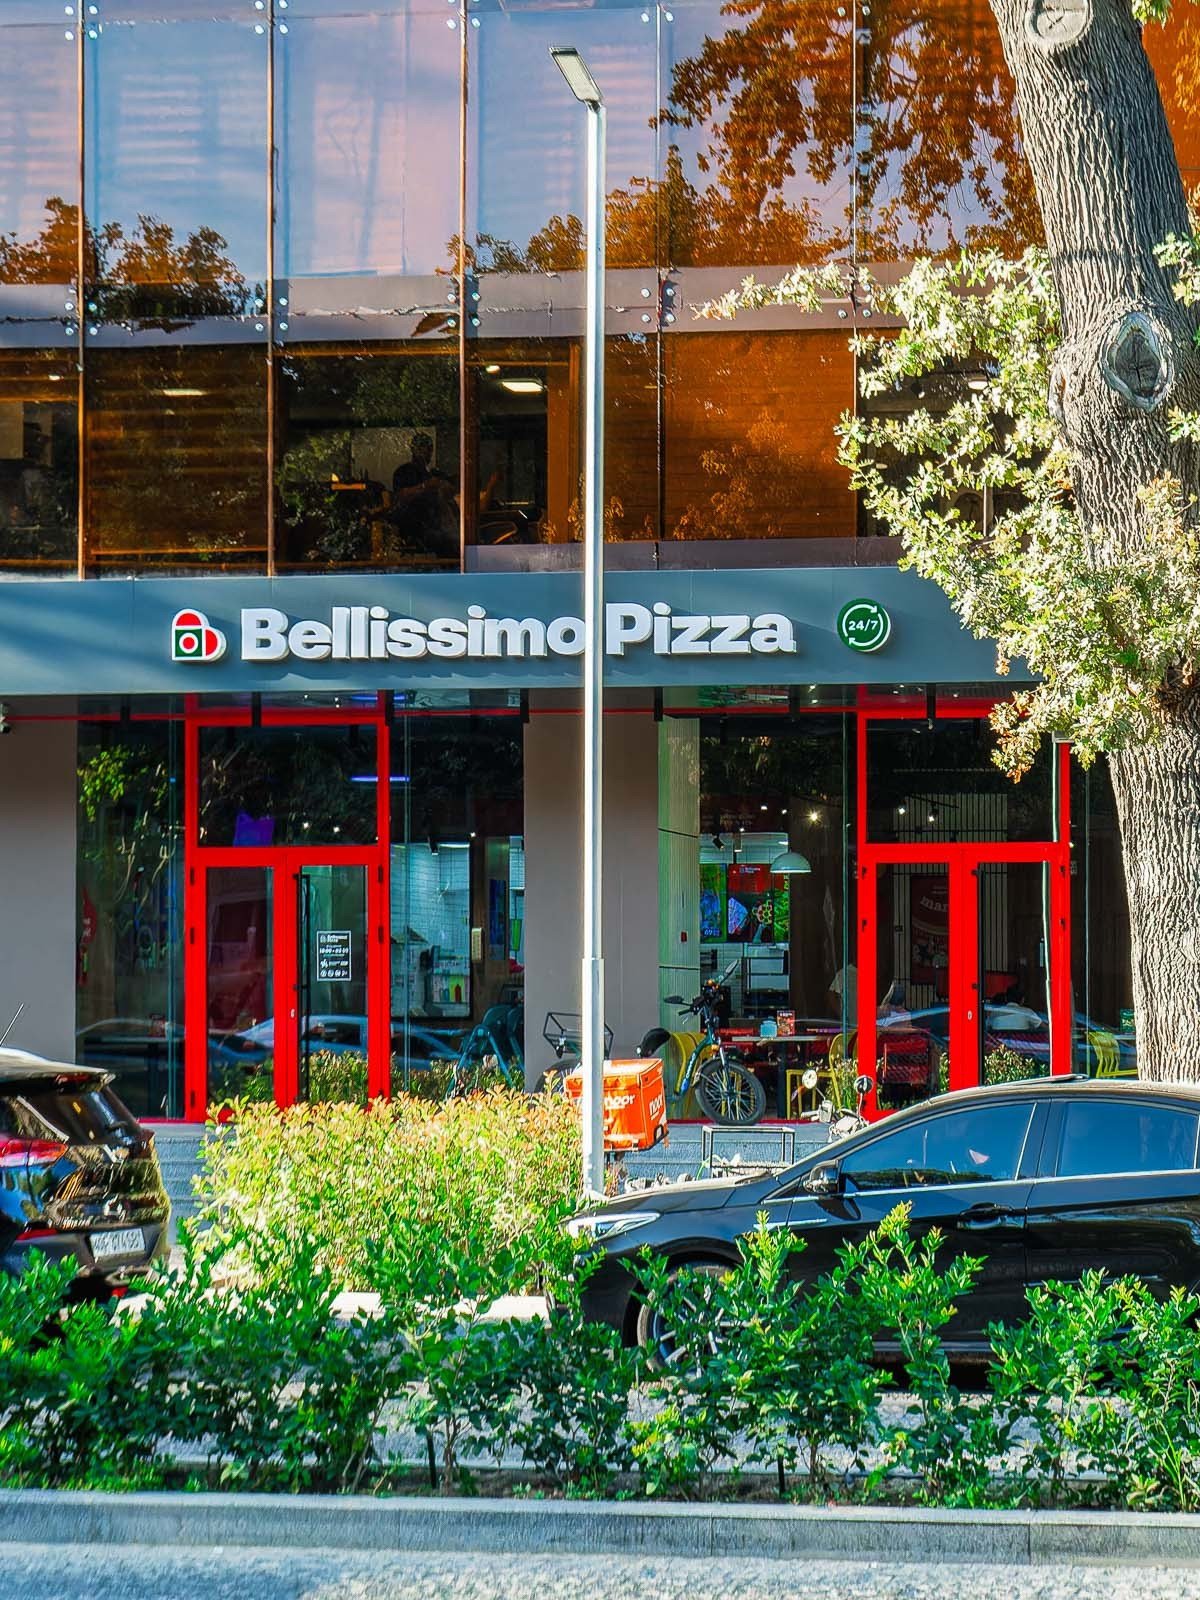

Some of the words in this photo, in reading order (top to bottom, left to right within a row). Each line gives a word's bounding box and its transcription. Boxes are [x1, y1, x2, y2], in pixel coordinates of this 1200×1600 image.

[241, 604, 585, 661] Bellissimo
[605, 602, 797, 656] Pizza
[848, 619, 878, 632] 24/7
